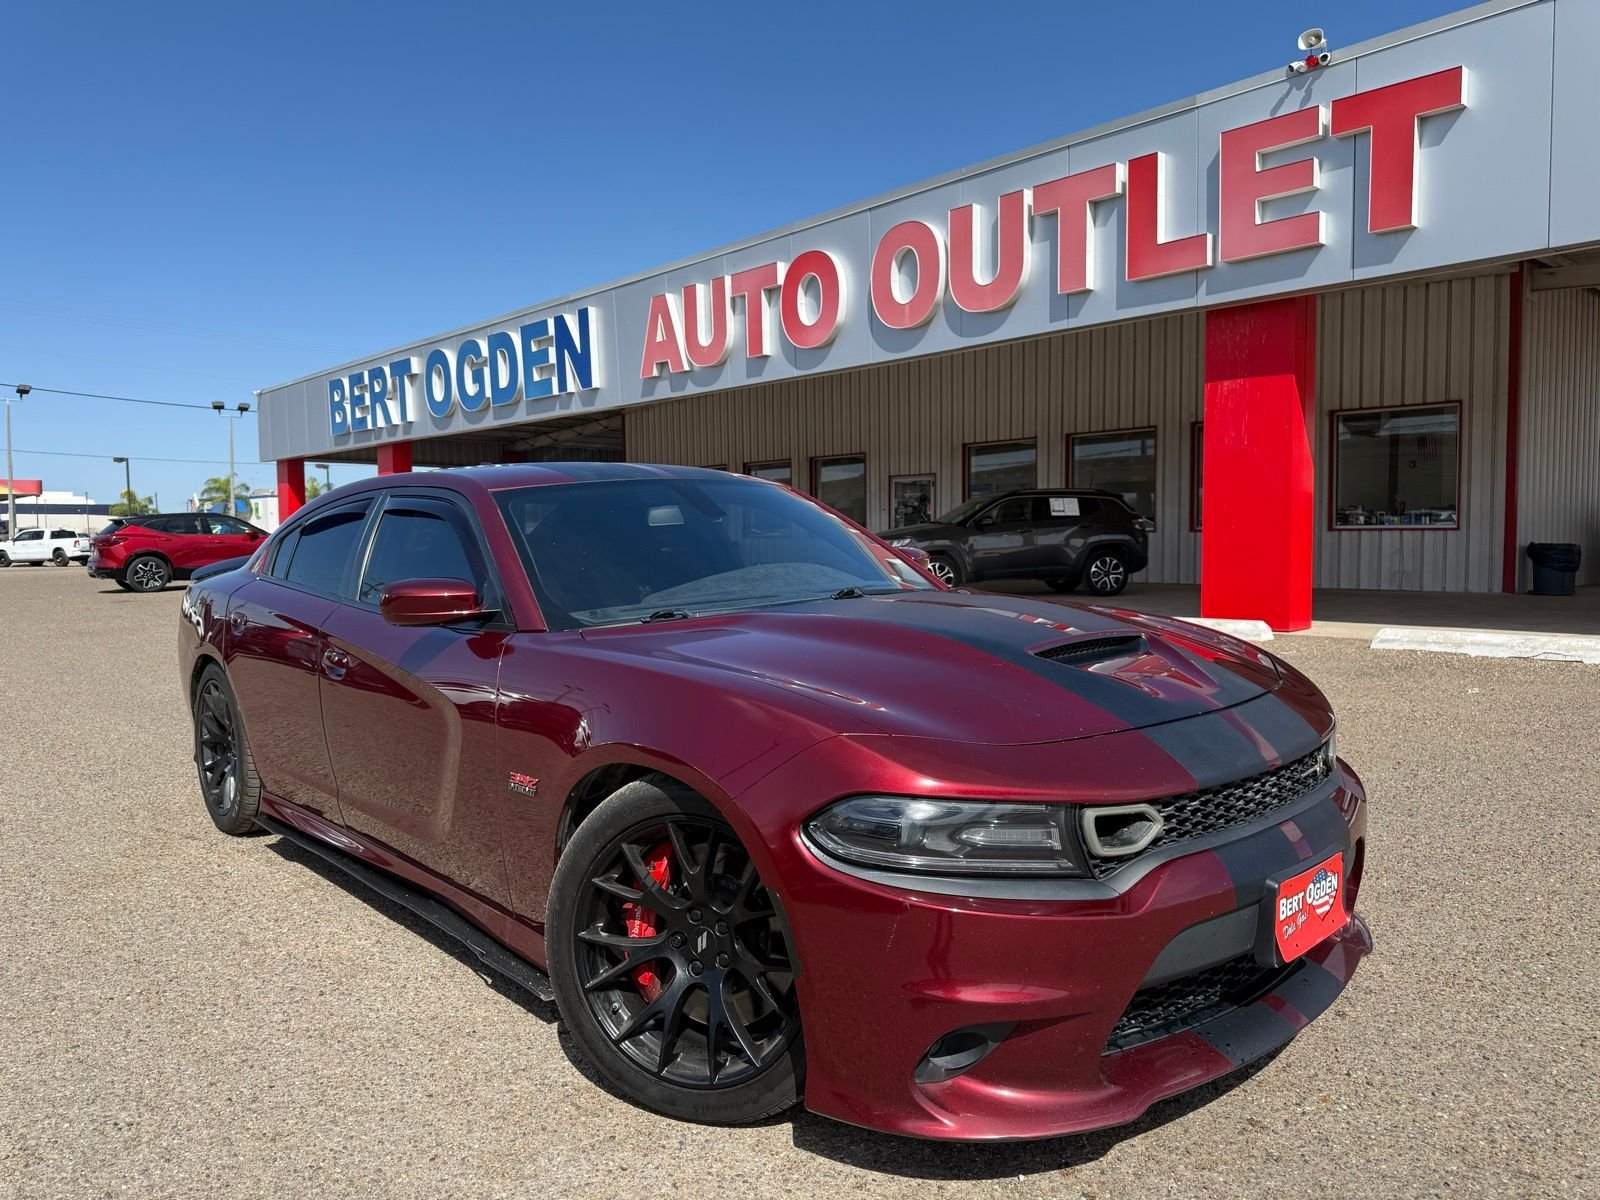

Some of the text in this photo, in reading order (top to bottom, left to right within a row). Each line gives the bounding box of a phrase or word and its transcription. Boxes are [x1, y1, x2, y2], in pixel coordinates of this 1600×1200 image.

[328, 66, 1468, 436] BERT OGDEN AUTO OUTLET
[510, 771, 539, 789] 392
[1280, 873, 1338, 921] BERT OGDEN
